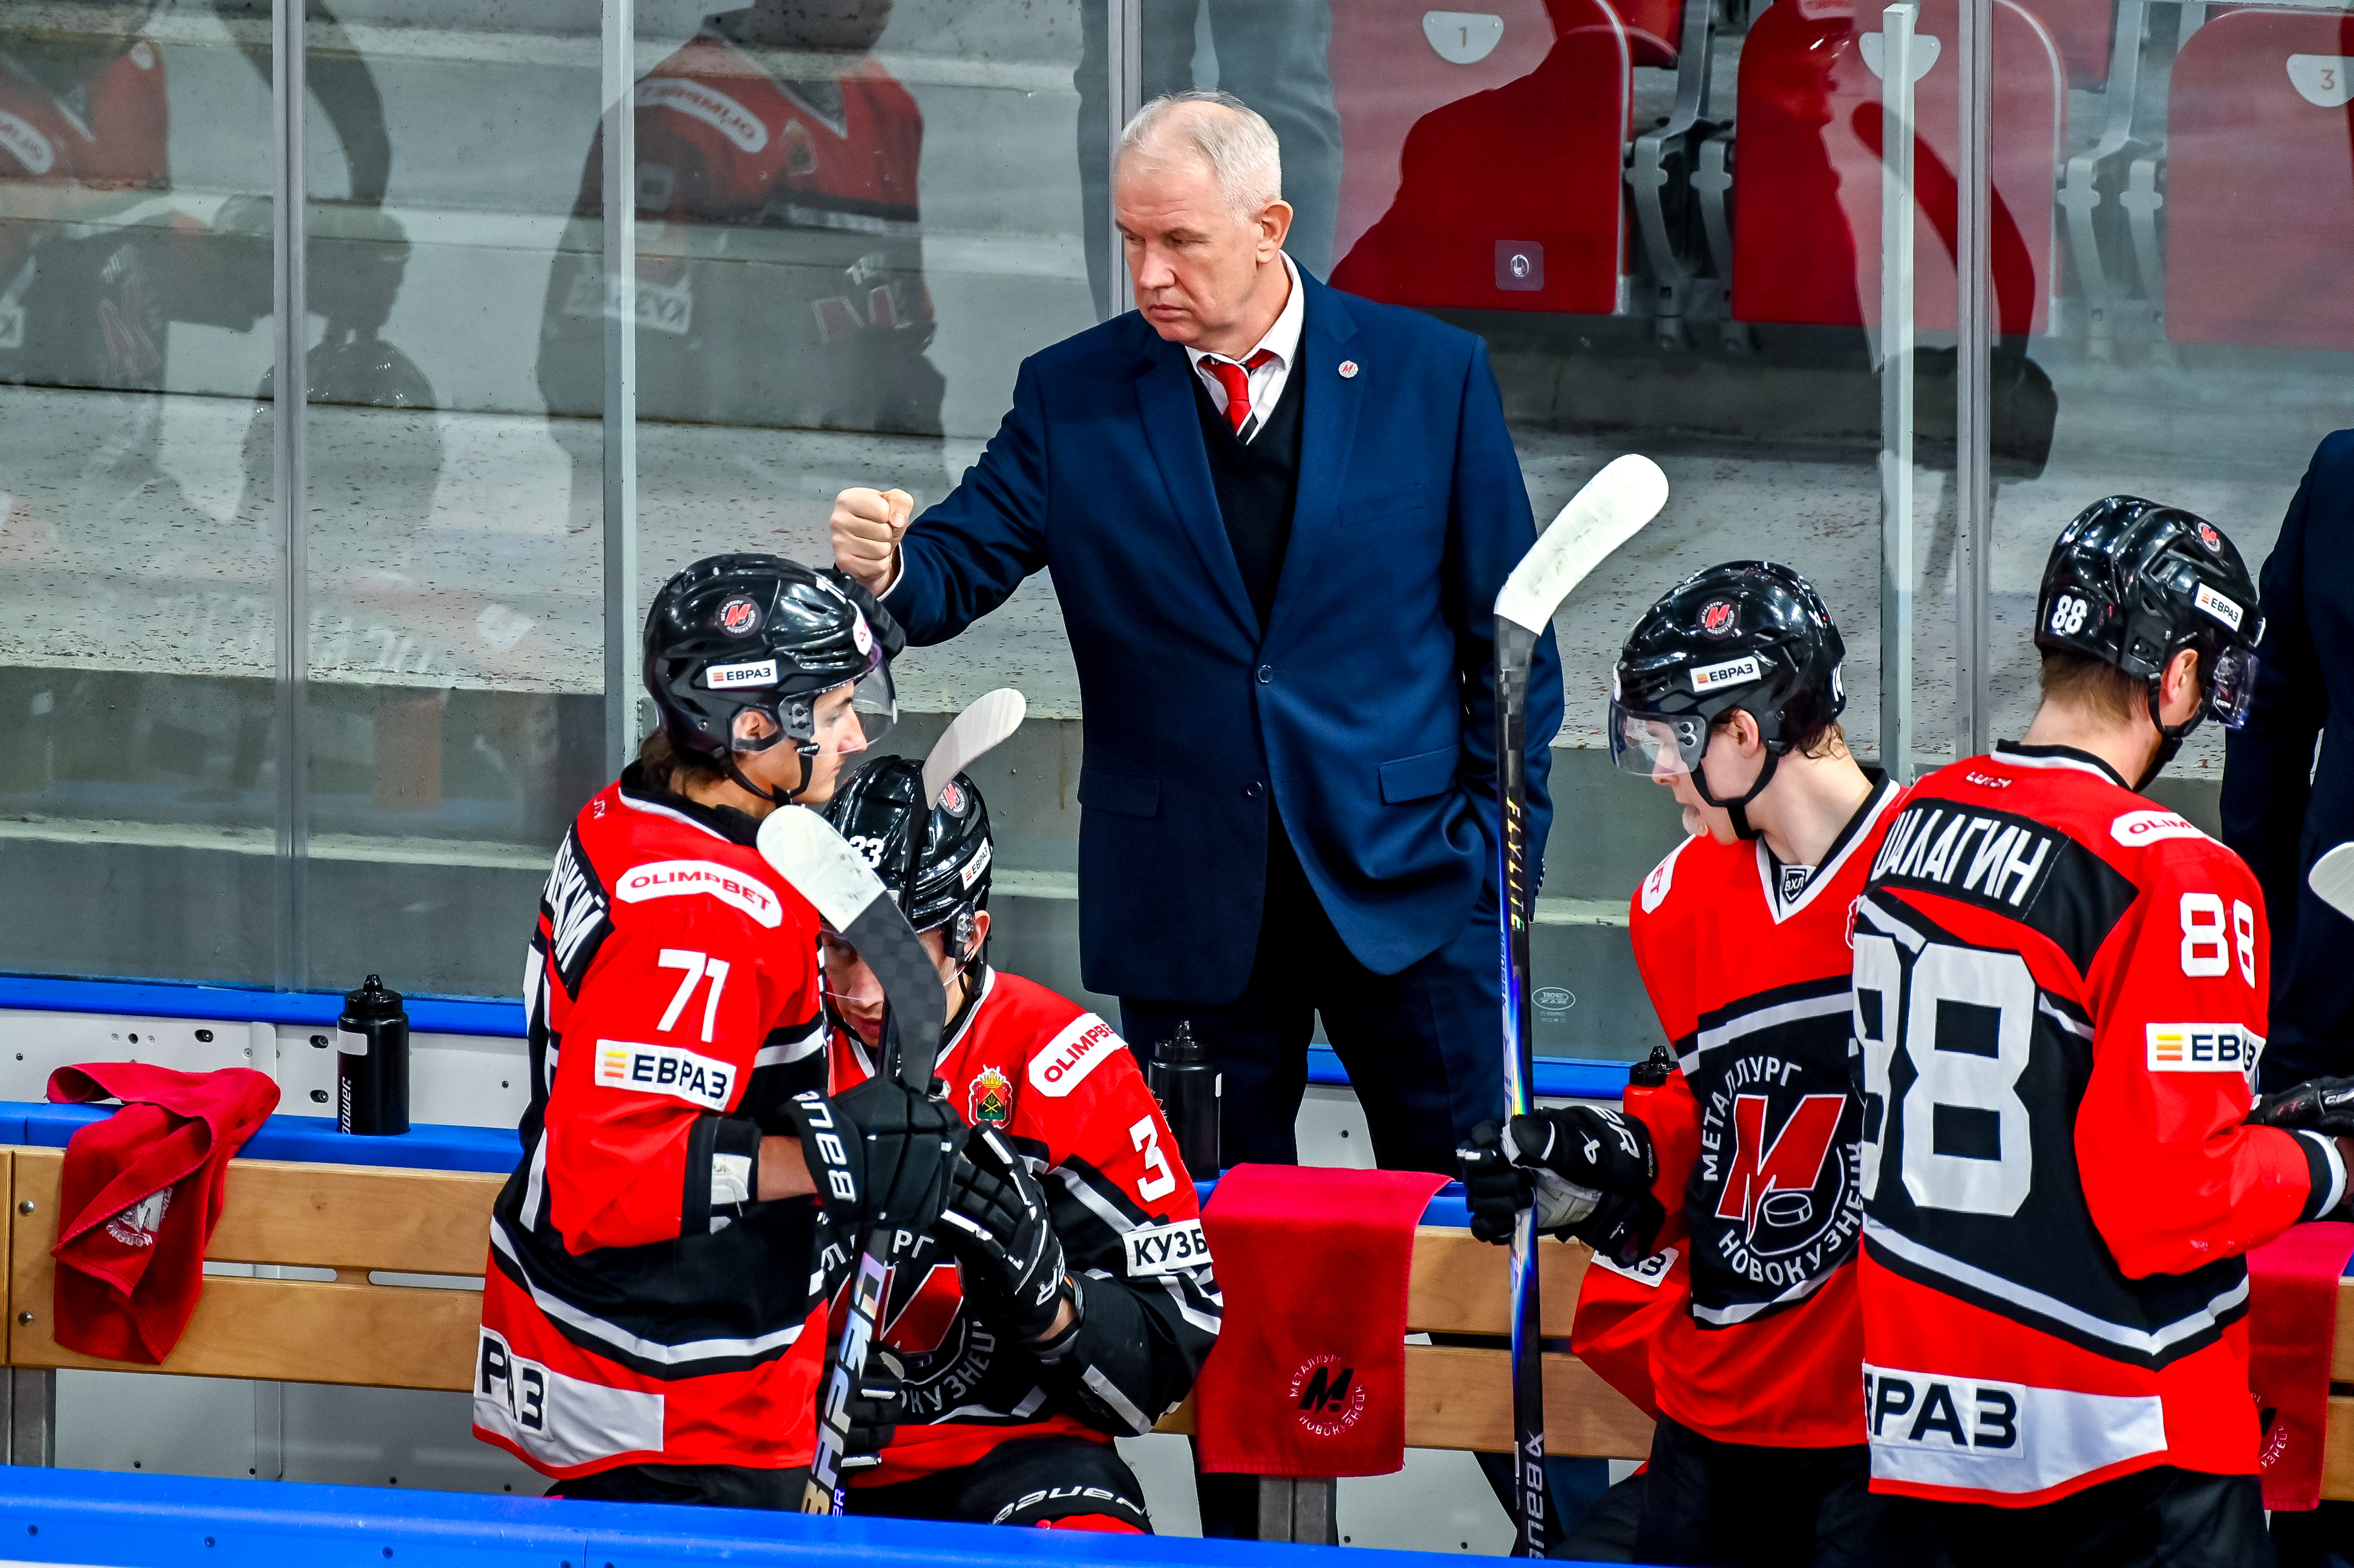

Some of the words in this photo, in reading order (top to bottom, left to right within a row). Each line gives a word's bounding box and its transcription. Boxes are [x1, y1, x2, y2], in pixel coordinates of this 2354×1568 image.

[1459, 26, 1468, 47] 1
[2321, 68, 2335, 91] 3
[2051, 595, 2088, 635] 88
[2210, 597, 2239, 622] ЕВРАЗ
[726, 667, 771, 681] ЕВРАЗ
[1708, 663, 1754, 682] ЕВРАЗ
[970, 846, 989, 875] ЕВРАЗ
[630, 871, 771, 911] OLIMPBET
[1784, 876, 1805, 892] ВХЛ
[2180, 892, 2257, 989] 88
[656, 949, 730, 1043] 71
[632, 1053, 727, 1099] ЕВРАЗ
[1852, 932, 2036, 1218] 88
[1702, 1056, 1802, 1181] МЕТАЛЛУРГ
[1128, 1114, 1176, 1203] 3
[1133, 1228, 1209, 1267] КУЗБ
[901, 1321, 996, 1414] КУЗНЕЦ
[1289, 1354, 1343, 1397] МЕТАЛЛУРГ
[1299, 1383, 1366, 1436] НОВОКУЗНЕЦК
